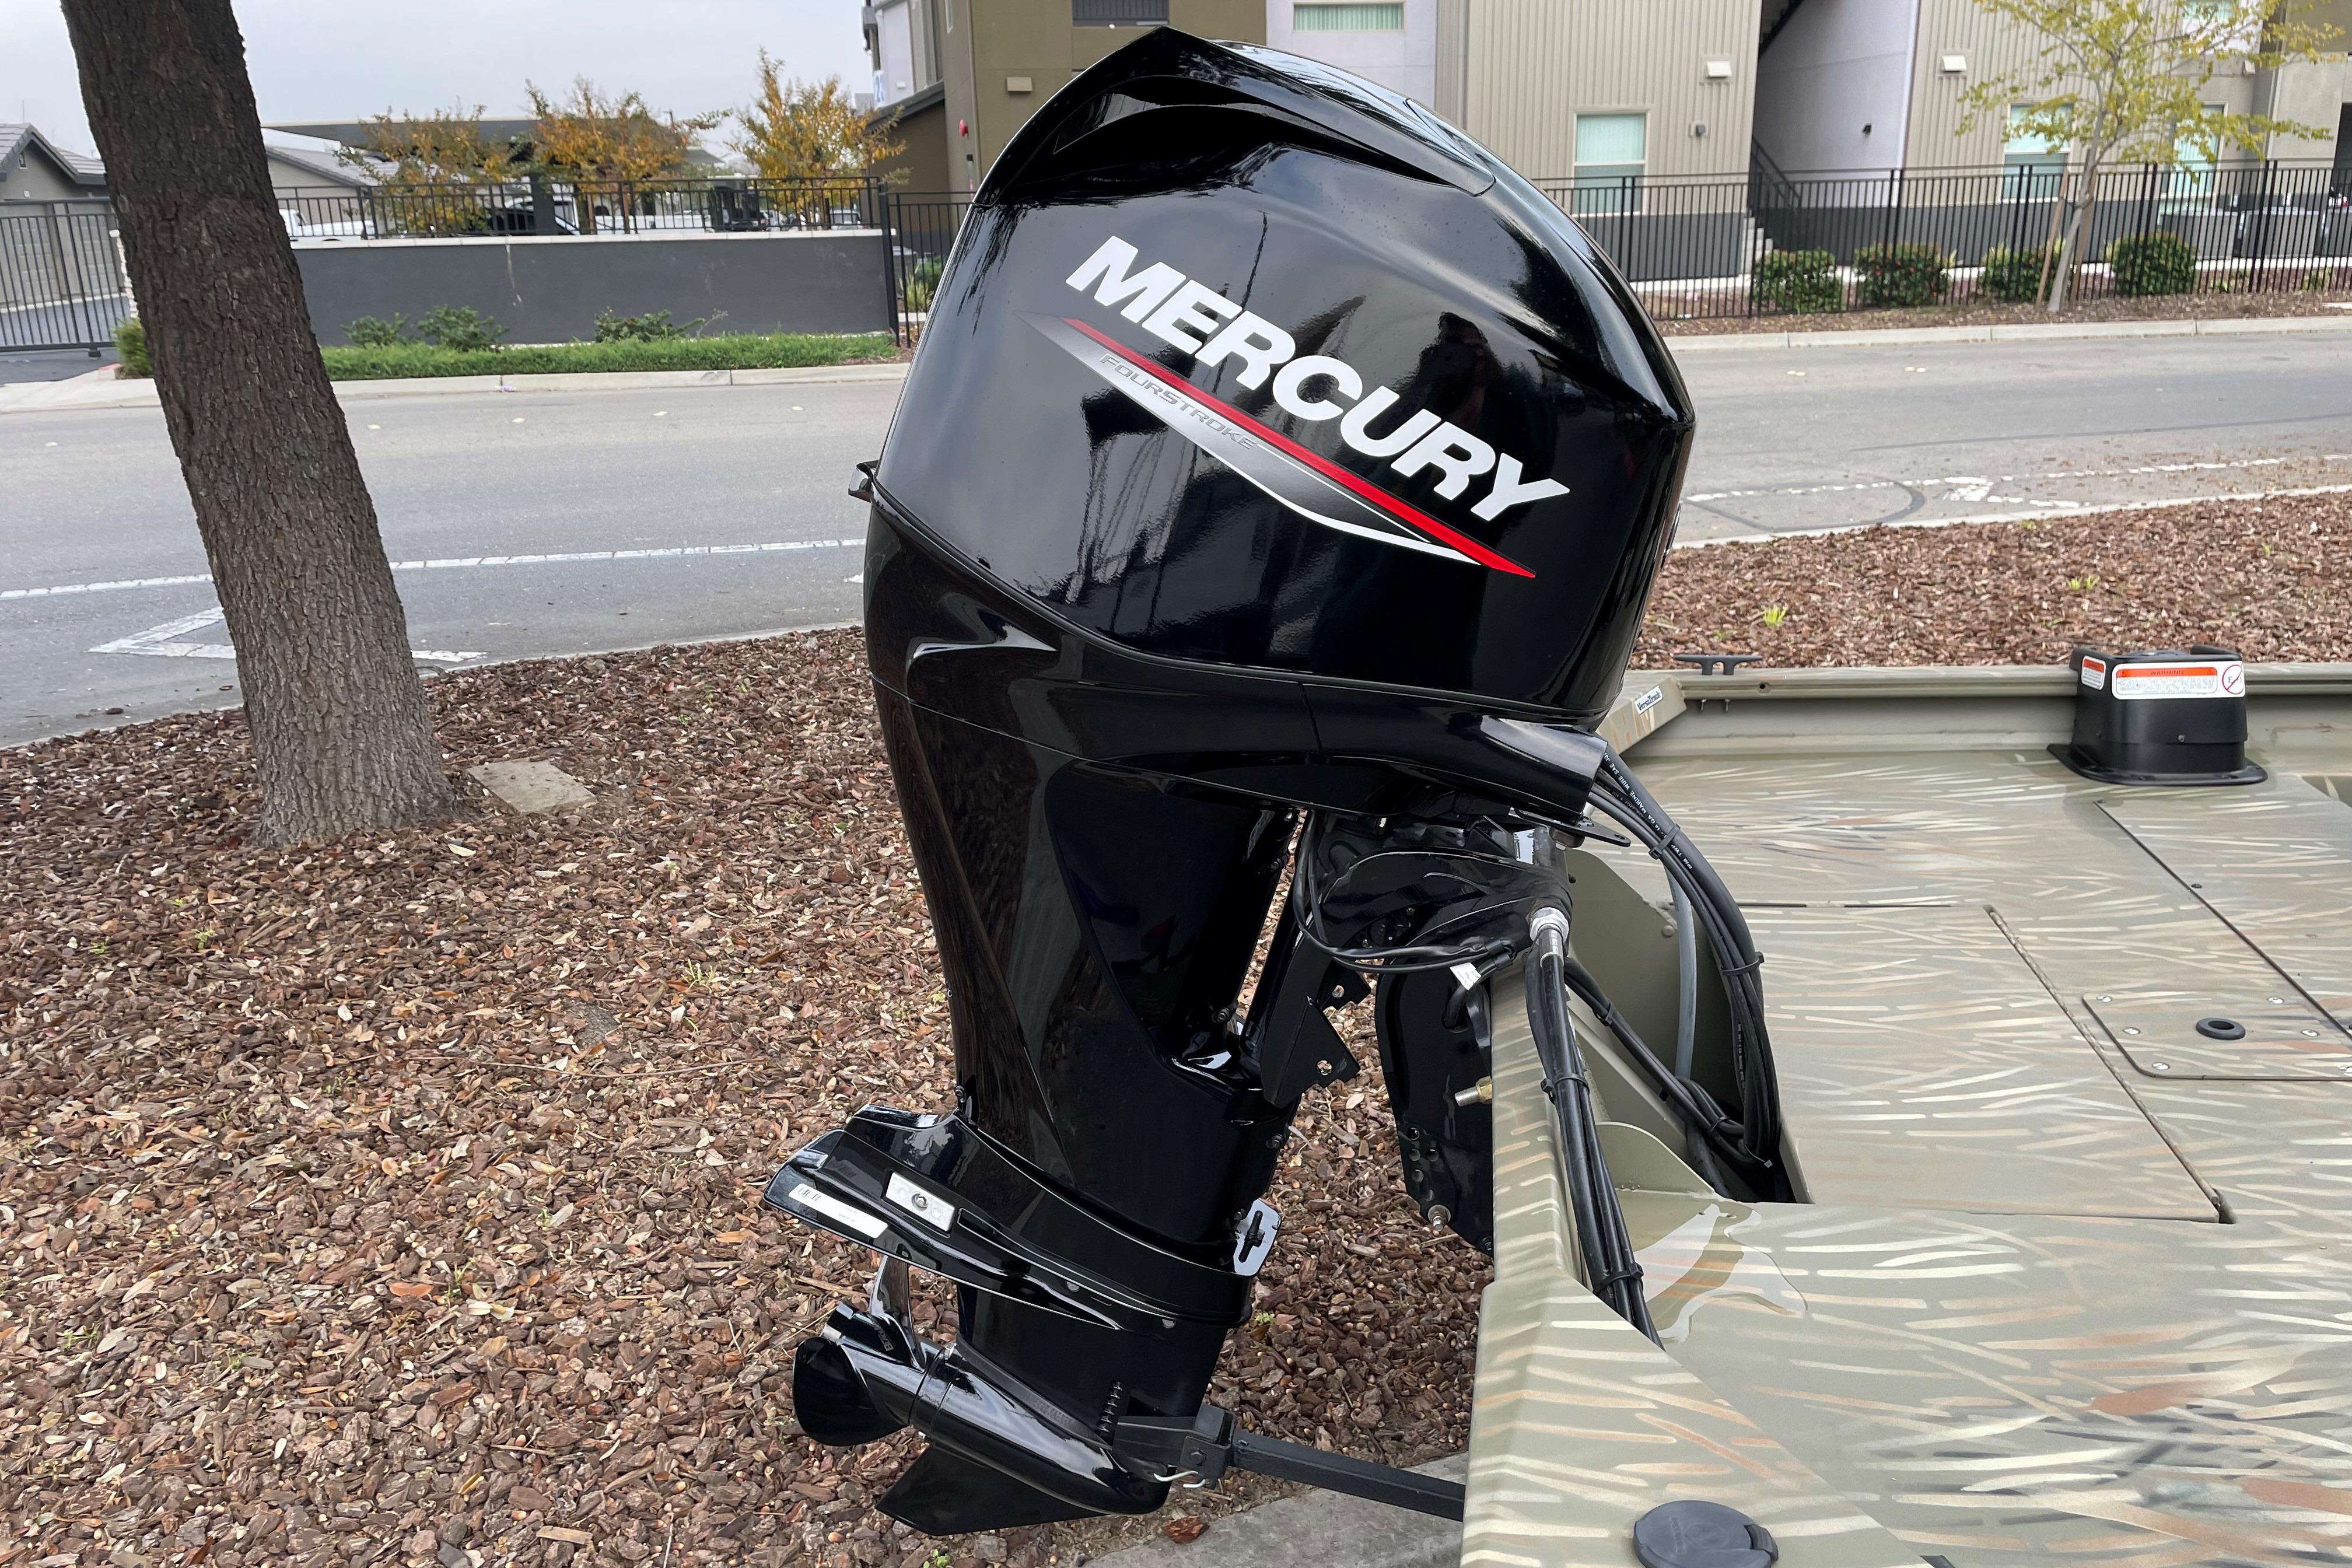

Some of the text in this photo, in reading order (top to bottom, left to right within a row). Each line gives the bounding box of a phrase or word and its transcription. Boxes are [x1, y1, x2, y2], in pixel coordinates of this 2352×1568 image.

[1066, 235, 1570, 521] MERCURY
[1100, 353, 1256, 449] FOURSTROKE
[1609, 762, 1619, 775] SAE
[1618, 775, 1630, 790] WIRE
[1629, 790, 1647, 814] MARINE
